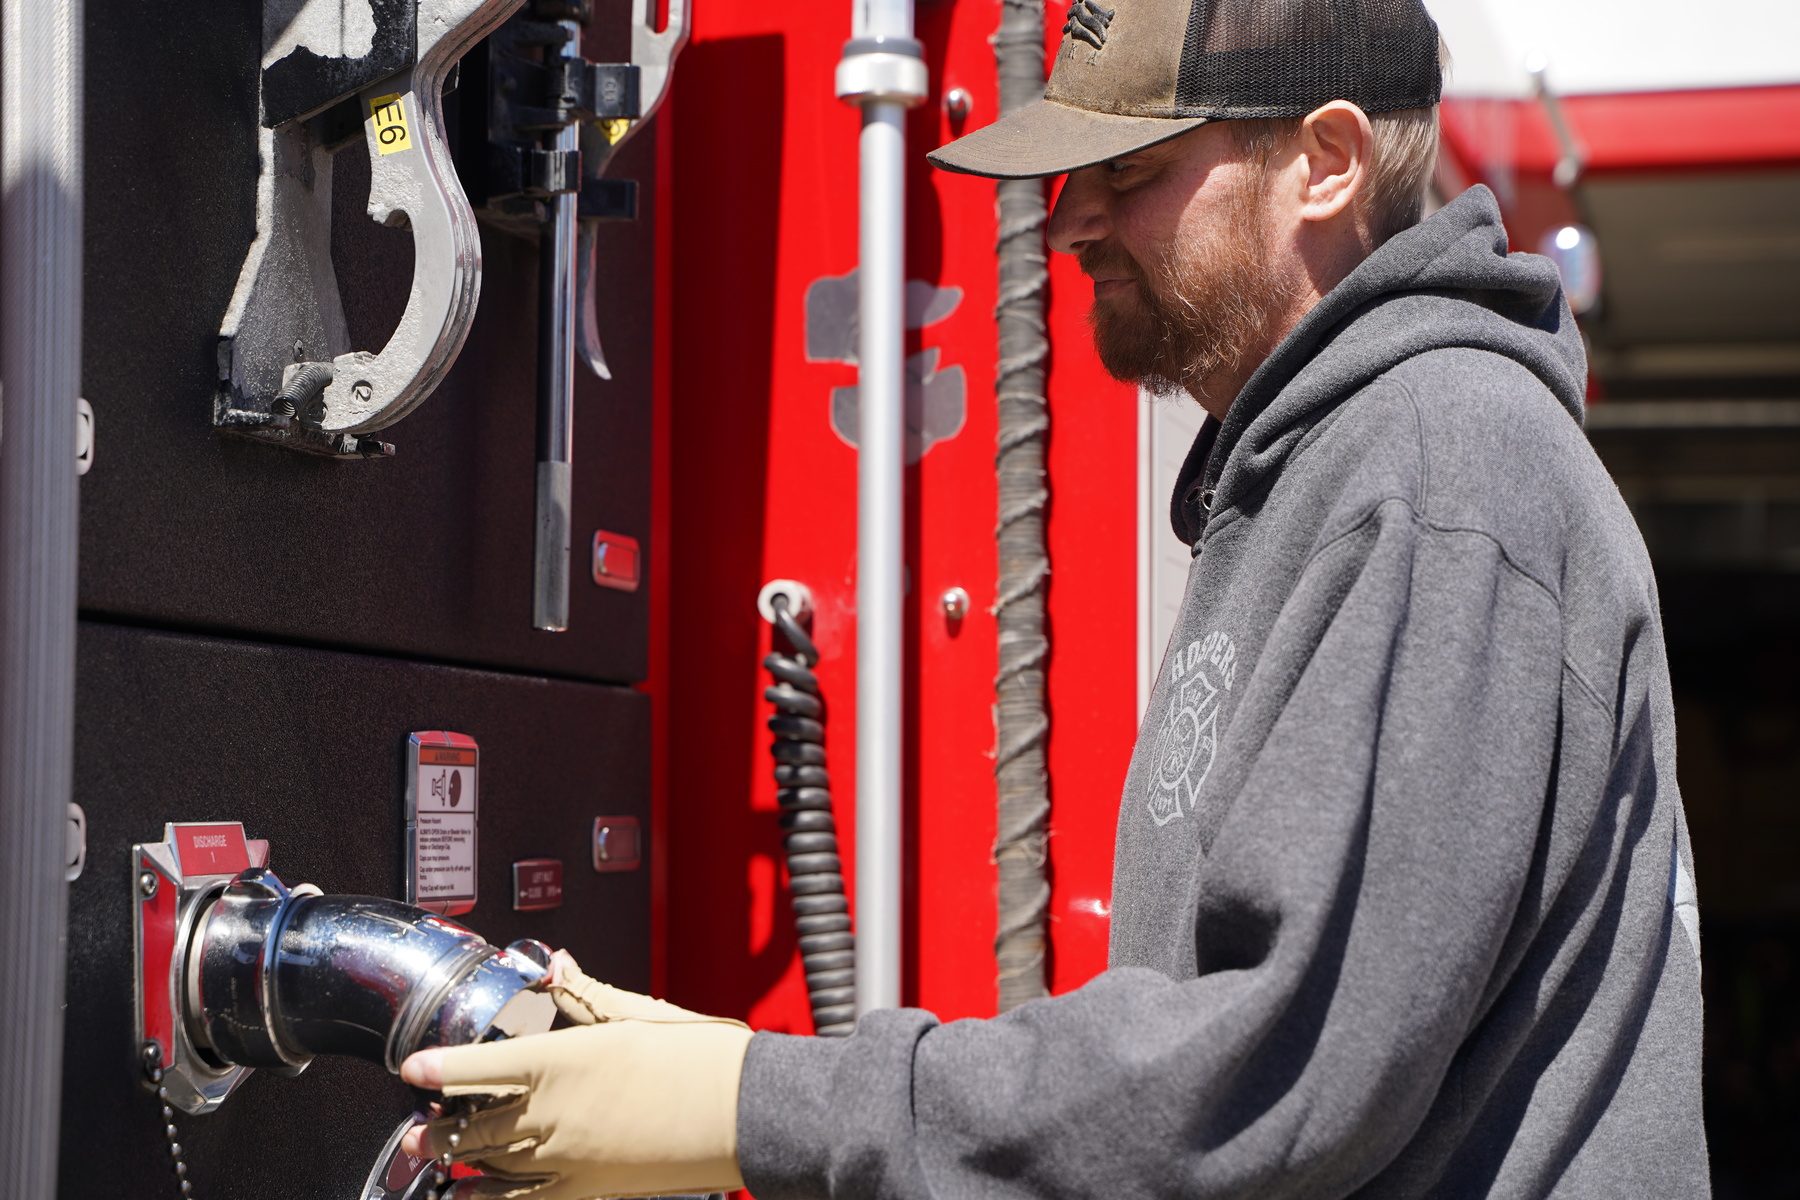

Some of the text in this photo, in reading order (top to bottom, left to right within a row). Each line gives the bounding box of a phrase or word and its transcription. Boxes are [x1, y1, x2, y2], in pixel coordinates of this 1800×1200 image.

[374, 100, 406, 145] E6
[439, 752, 461, 762] WARNING
[193, 835, 227, 848] DISCHARGE
[210, 851, 215, 863] 1
[408, 1155, 422, 1172] INLE
